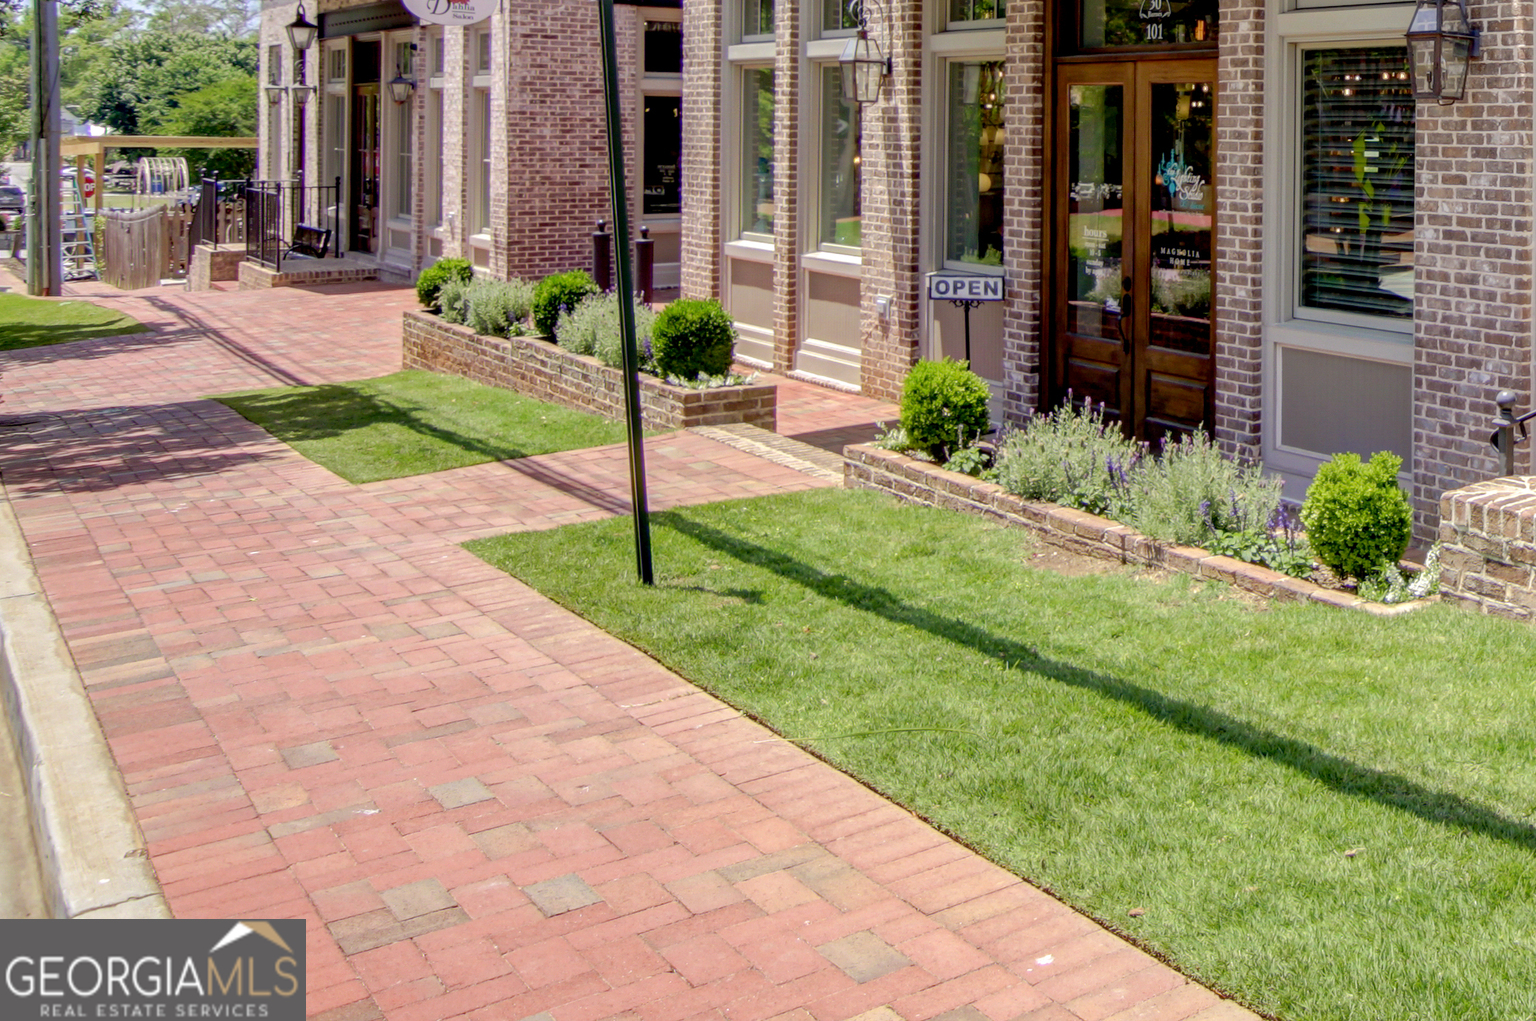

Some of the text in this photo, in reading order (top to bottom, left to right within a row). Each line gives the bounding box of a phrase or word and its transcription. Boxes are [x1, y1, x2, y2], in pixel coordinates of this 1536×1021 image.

[1146, 23, 1163, 40] 101
[84, 182, 96, 192] OP
[1084, 225, 1107, 238] hours
[1160, 247, 1200, 259] MAGNOLIA
[1169, 257, 1191, 266] HOME
[935, 279, 999, 296] OPEN
